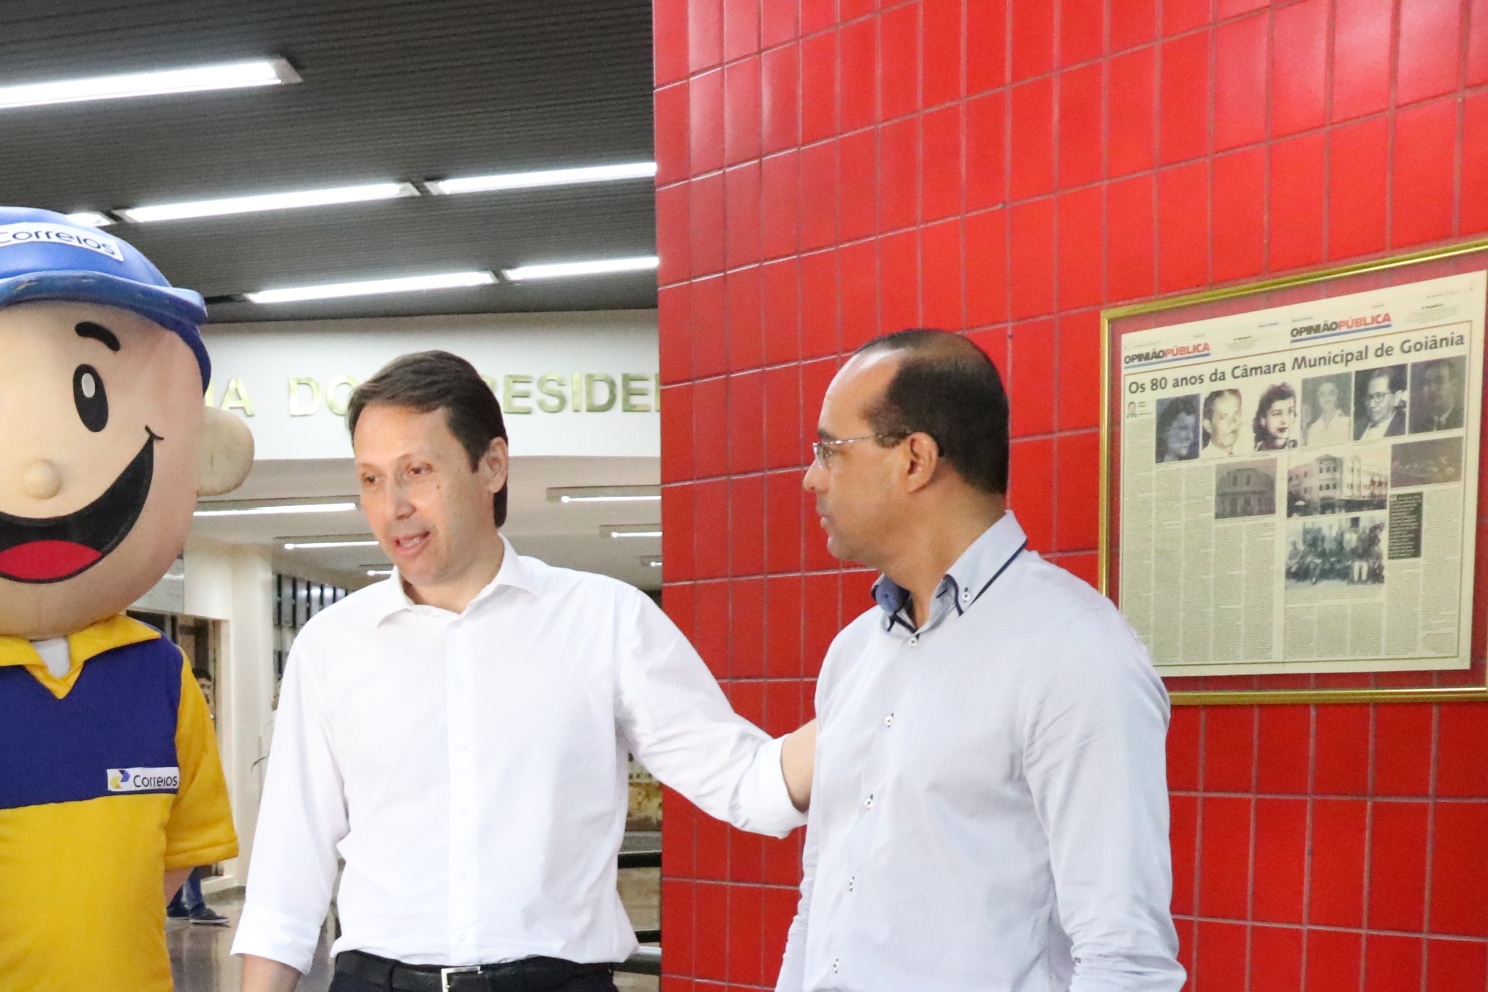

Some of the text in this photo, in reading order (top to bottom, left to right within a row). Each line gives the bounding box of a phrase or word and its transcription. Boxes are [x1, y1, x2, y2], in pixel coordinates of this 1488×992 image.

[1128, 332, 1465, 394] Os 80 anos da Câmara Municipal de Goiânia
[133, 775, 178, 788] Correios
